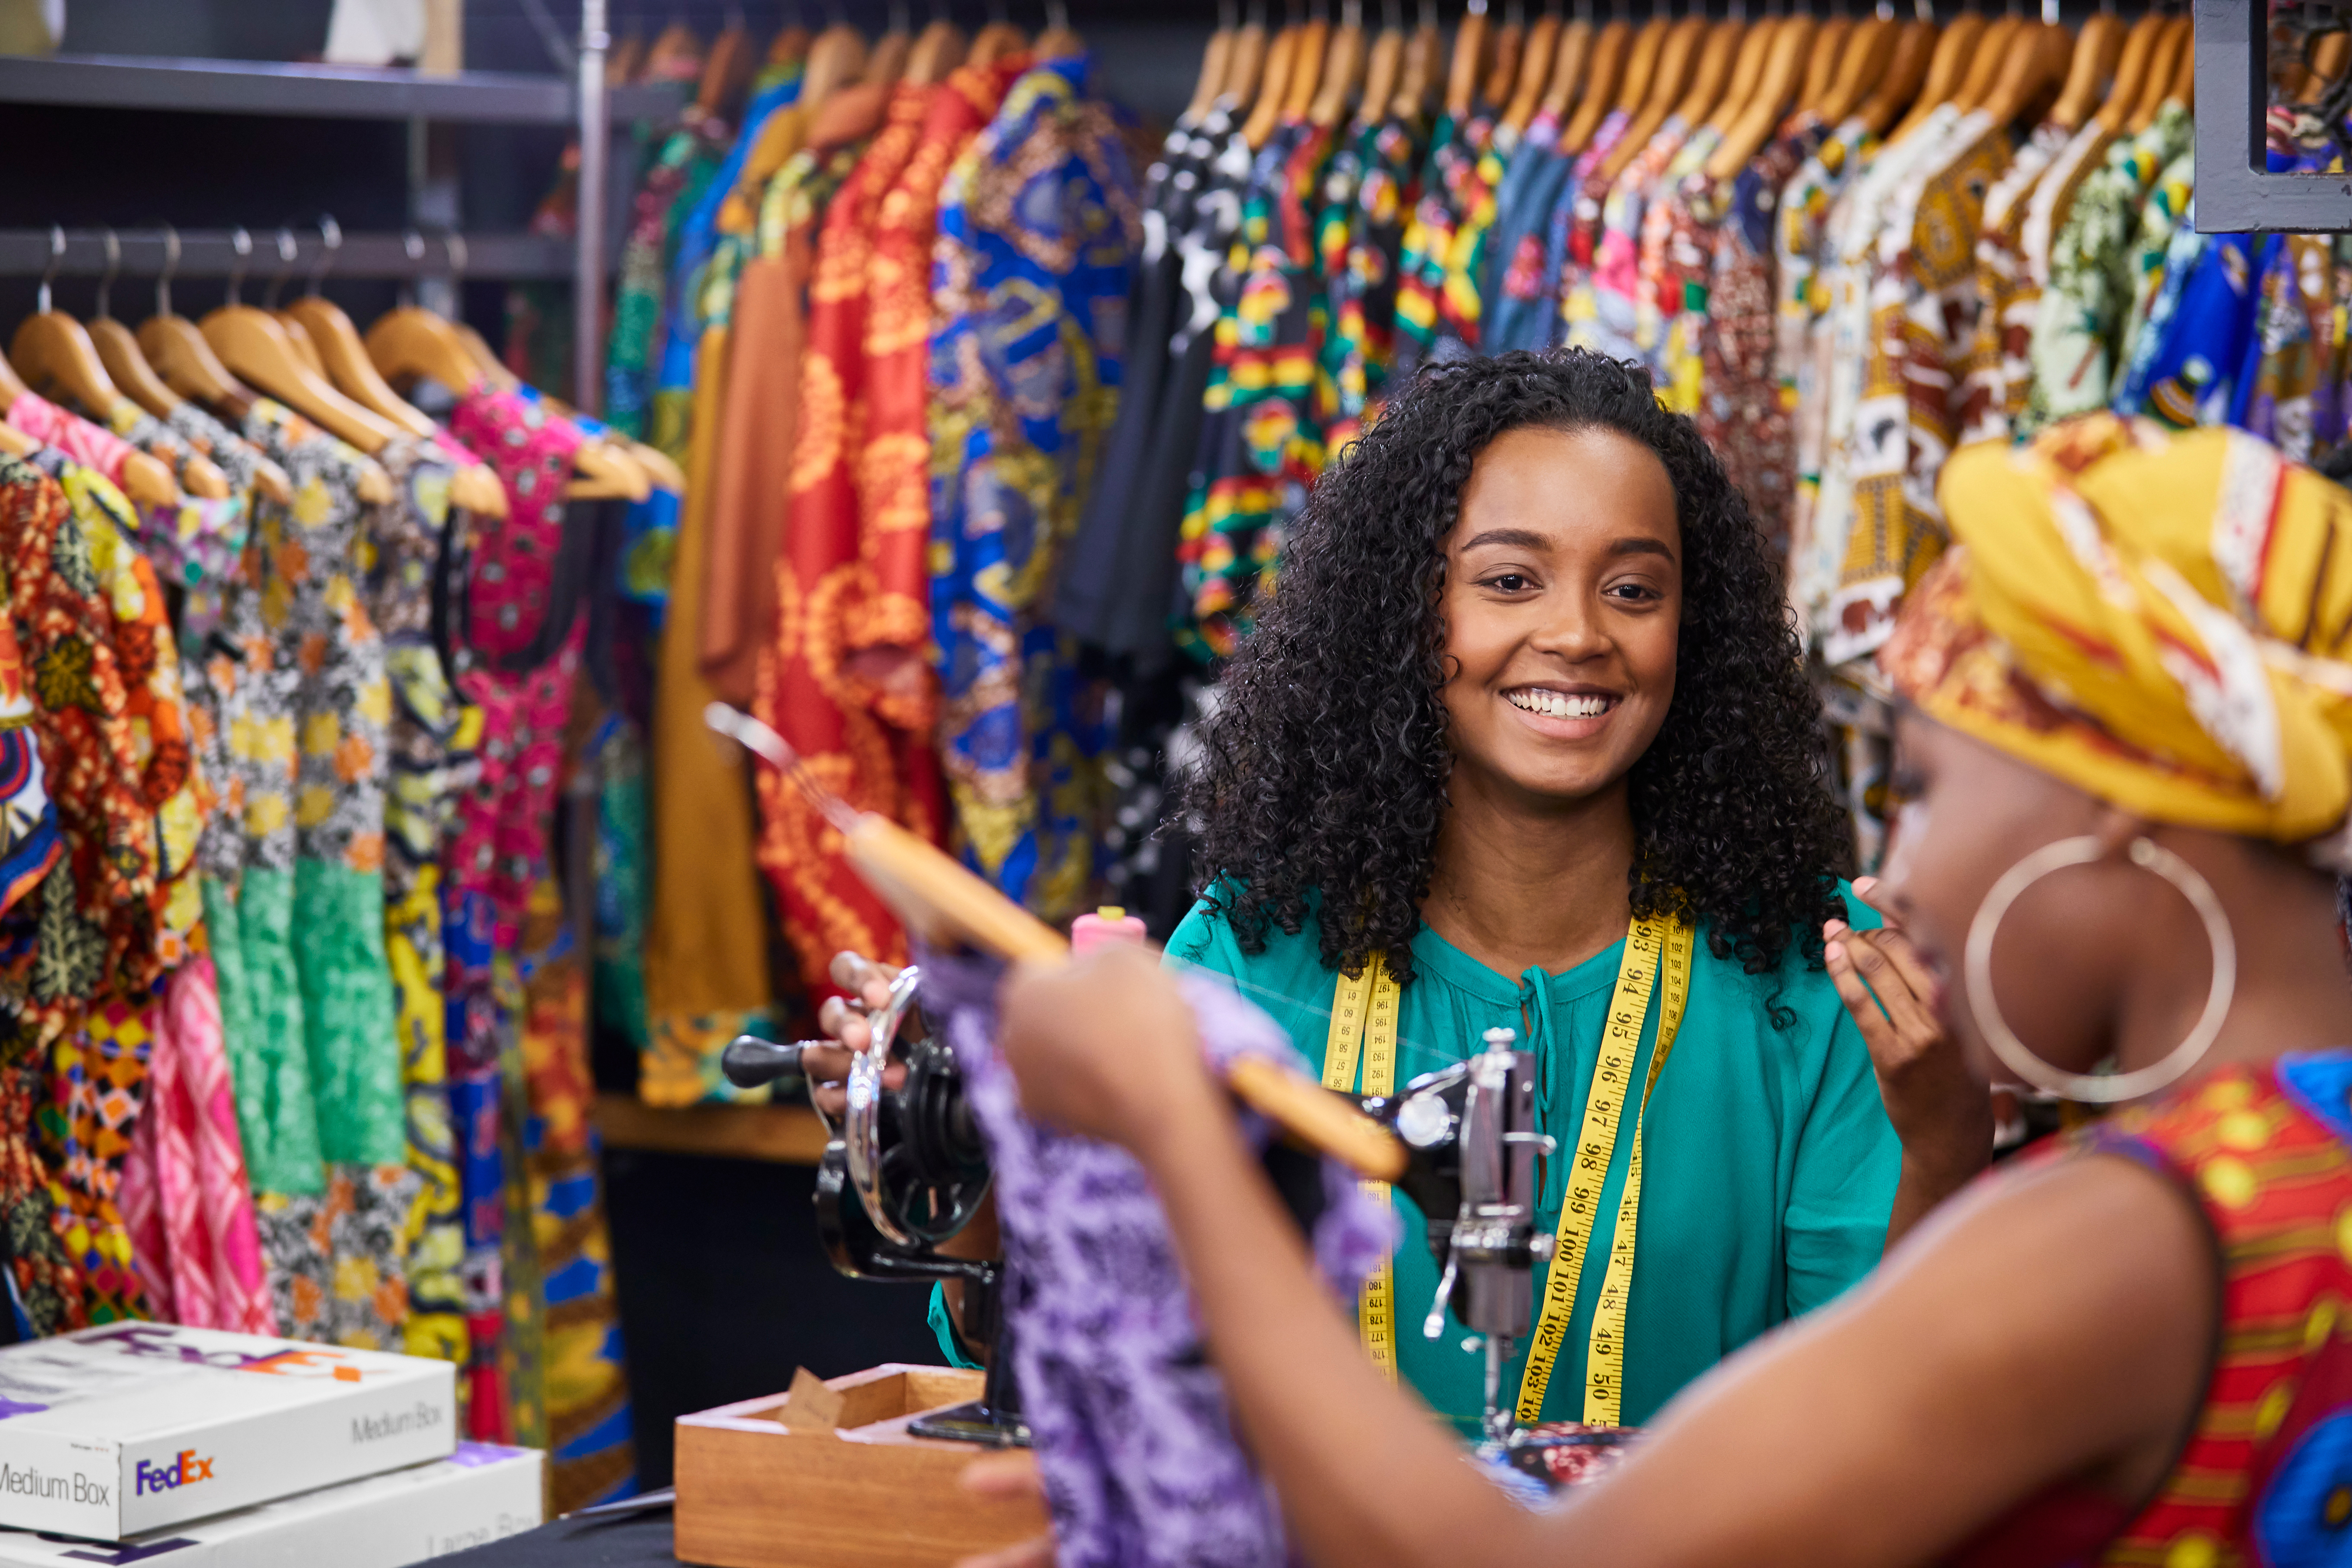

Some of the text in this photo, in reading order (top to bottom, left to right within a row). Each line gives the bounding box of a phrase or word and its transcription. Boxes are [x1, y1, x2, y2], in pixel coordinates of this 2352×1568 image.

[1672, 926, 1684, 935] 101
[1671, 942, 1683, 952] 102
[1671, 959, 1681, 969] 103
[1671, 976, 1681, 985] 104
[1378, 984, 1390, 993] 197
[1670, 992, 1680, 1002] 105
[1377, 1001, 1388, 1009] 196
[1344, 1009, 1353, 1017] 60
[1668, 1009, 1677, 1020] 106
[1375, 1018, 1387, 1027] 195
[1341, 1026, 1350, 1035] 59
[1375, 1036, 1386, 1044] 194
[1339, 1044, 1348, 1053] 58
[1373, 1053, 1385, 1062] 193
[1337, 1062, 1345, 1070] 57
[1372, 1070, 1384, 1079] 192
[1334, 1079, 1342, 1087] 56
[1372, 1088, 1383, 1096] 191
[1631, 1151, 1638, 1177] 45
[1521, 925, 1652, 1422] 93 94 95 96 97 98 99 100 101 102 103 10
[1620, 1195, 1632, 1221] 46
[1615, 1239, 1627, 1266] 47
[1369, 1282, 1382, 1290] 180
[1603, 1283, 1619, 1310] 48
[1369, 1298, 1383, 1308] 179
[1370, 1316, 1383, 1325] 178
[1372, 1333, 1384, 1342] 177
[1596, 1328, 1612, 1355] 49
[1593, 1373, 1610, 1400] 50
[136, 1449, 214, 1496] FedEx
[74, 1472, 110, 1506] Box
